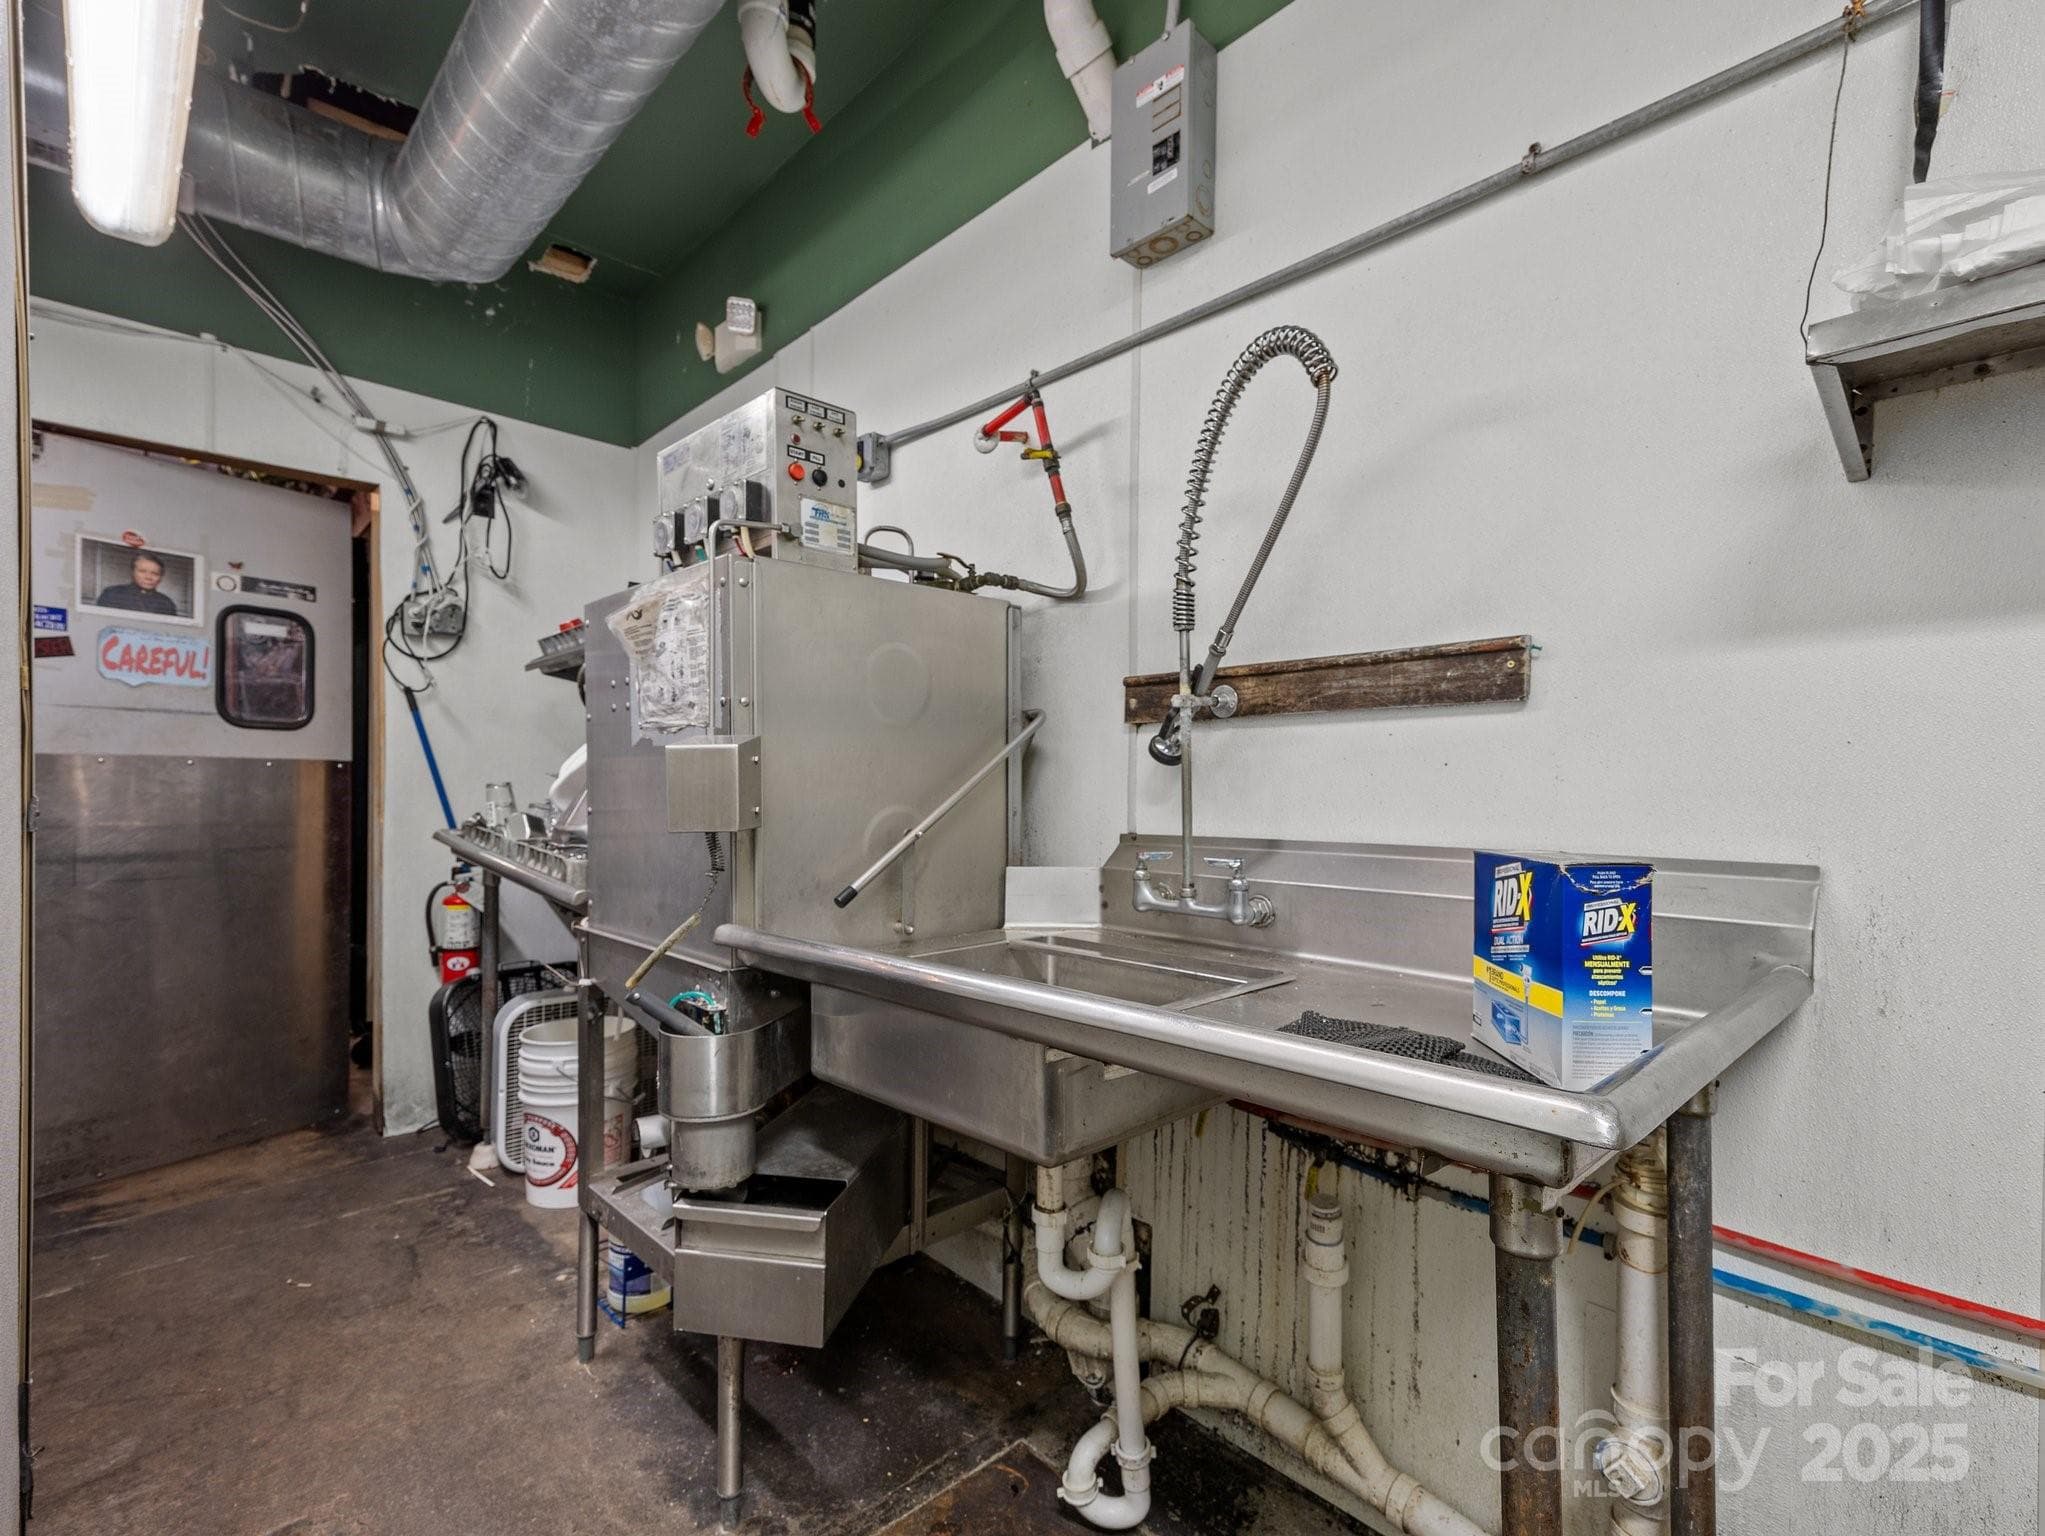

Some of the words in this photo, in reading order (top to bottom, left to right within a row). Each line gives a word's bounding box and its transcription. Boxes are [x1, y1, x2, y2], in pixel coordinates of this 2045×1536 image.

[101, 635, 210, 680] CAREFUL!
[1493, 871, 1533, 921] RID-X
[1583, 902, 1637, 937] RID-X
[1584, 960, 1630, 968] MENSUALMENTE
